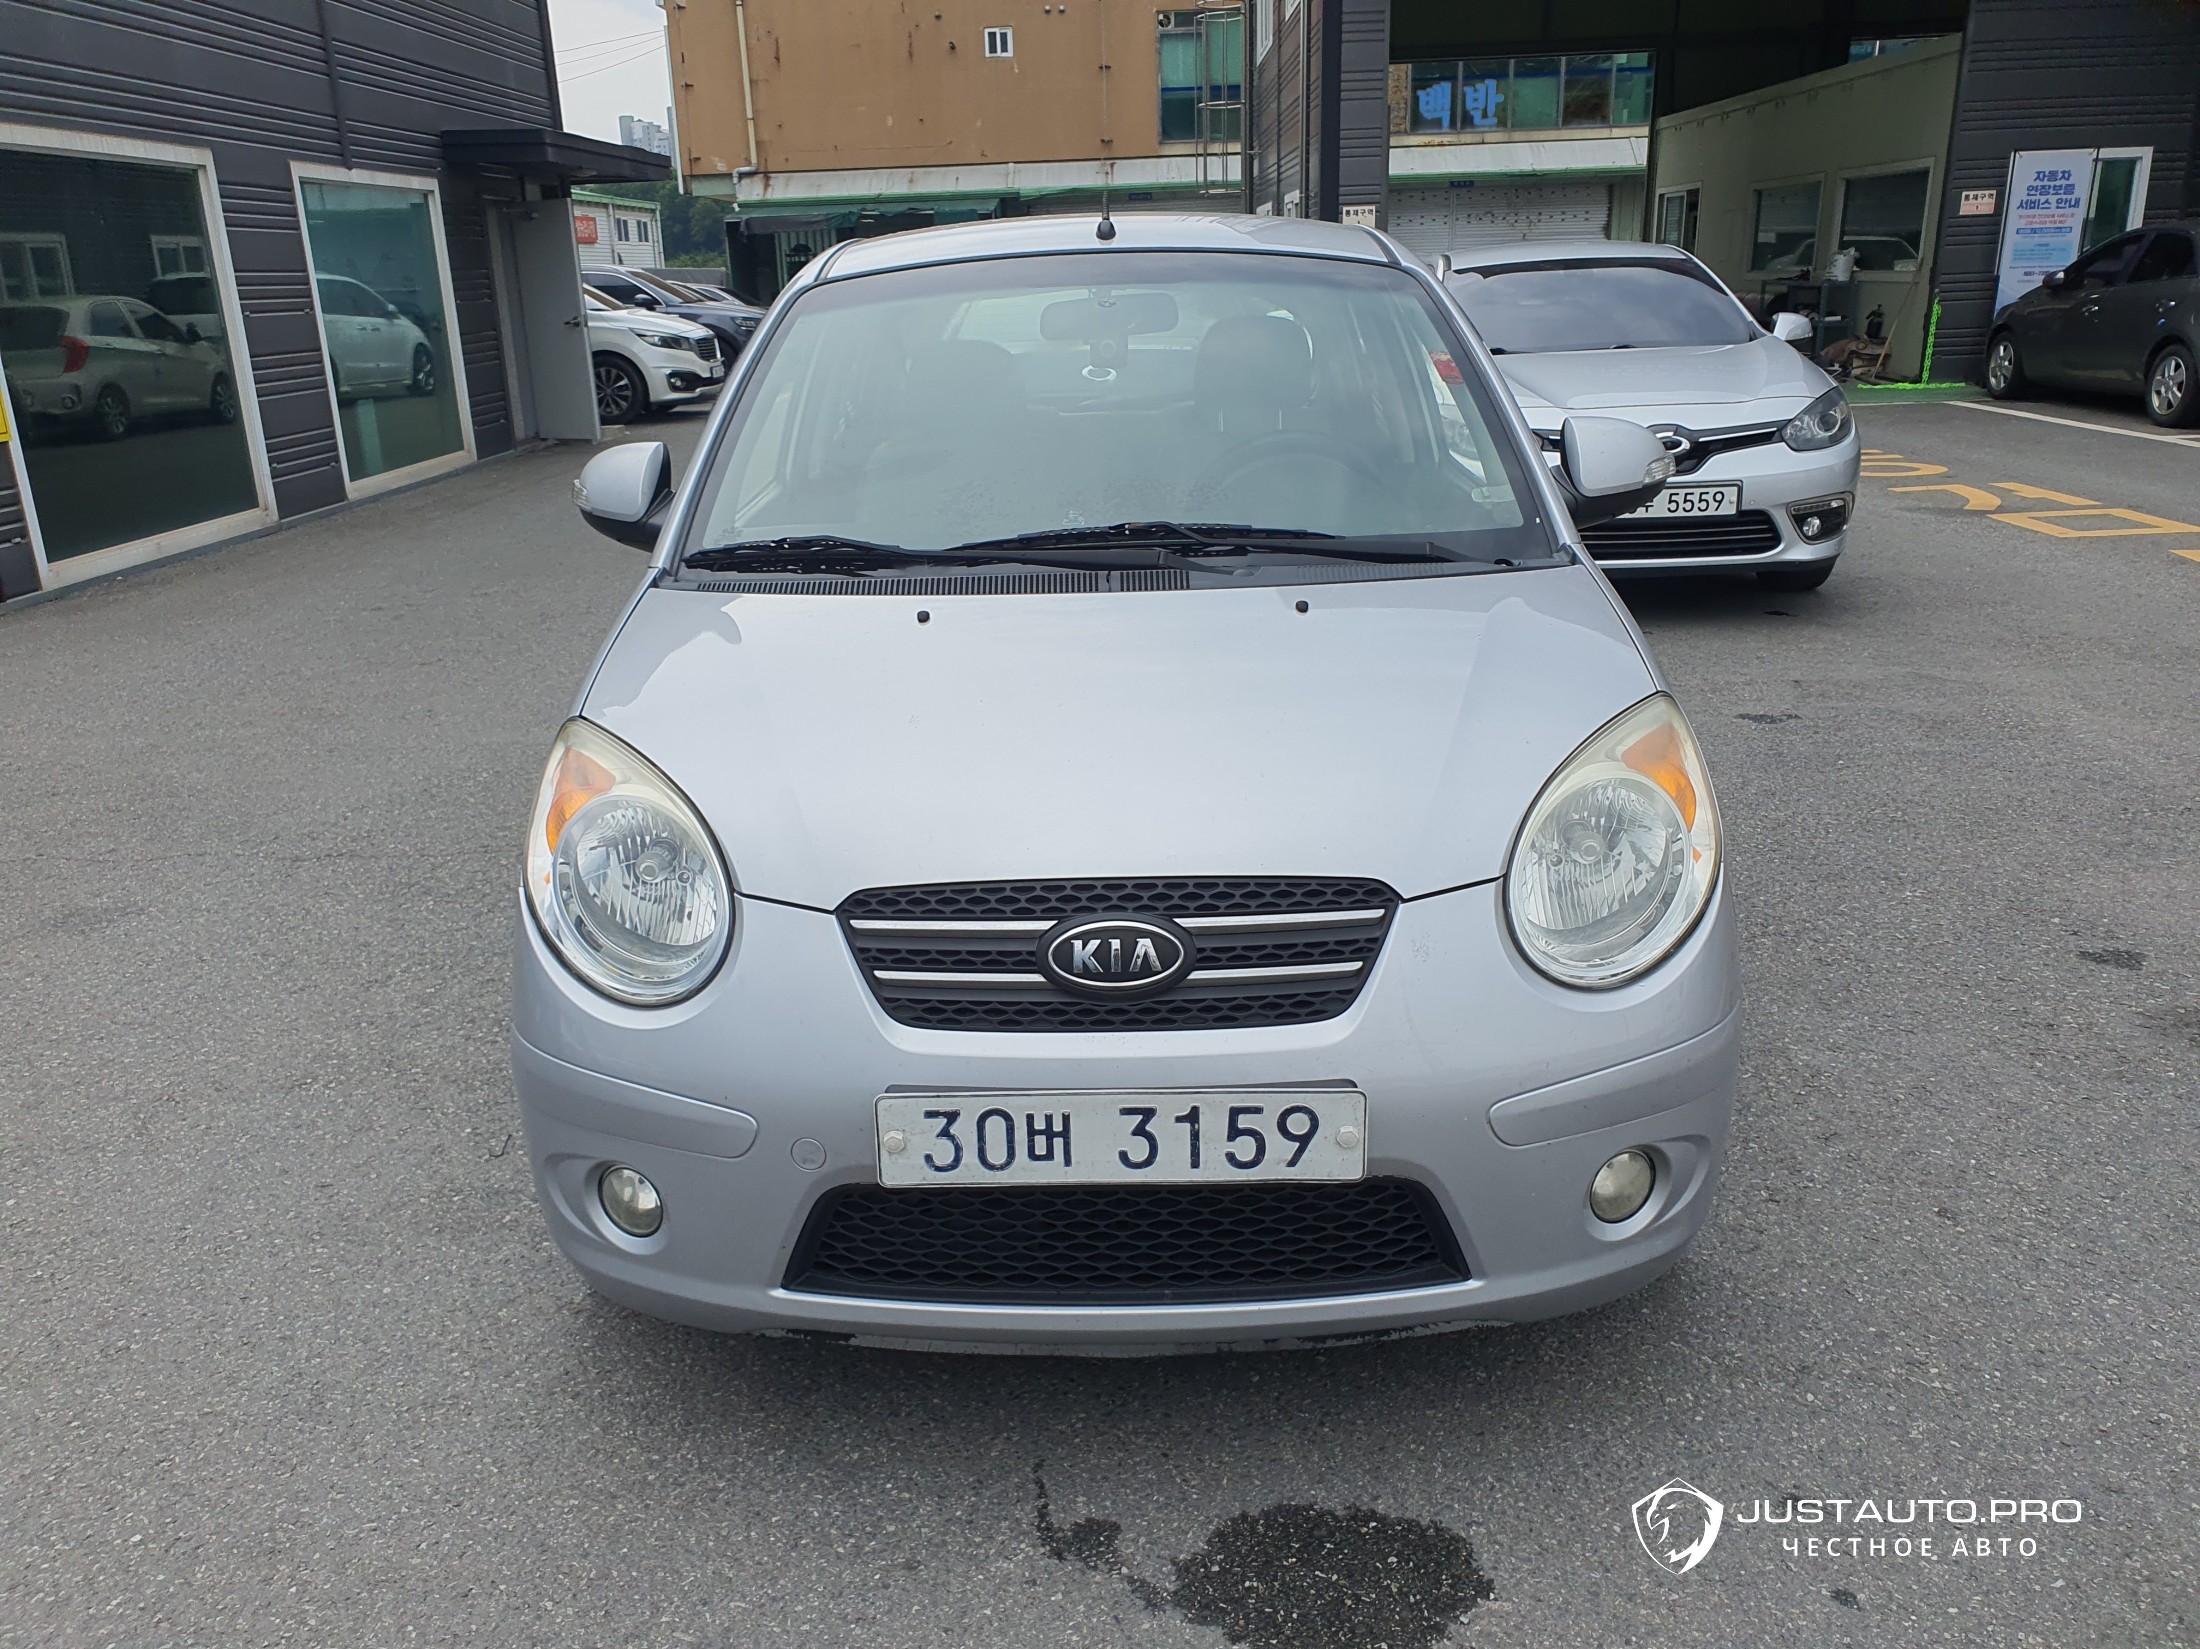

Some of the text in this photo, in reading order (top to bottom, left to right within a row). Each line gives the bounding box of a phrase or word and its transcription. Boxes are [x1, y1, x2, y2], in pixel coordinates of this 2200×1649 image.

[2034, 170, 2072, 182] 자동차
[2026, 183, 2075, 196] 연장보증
[1964, 193, 1995, 202] 통제구역
[2017, 198, 2081, 210] 서비스 안내
[1345, 208, 1374, 218] 통제구역
[1667, 491, 1726, 514] 5559
[1070, 937, 1163, 974] KIA
[923, 1103, 1321, 1174] 30버 3159
